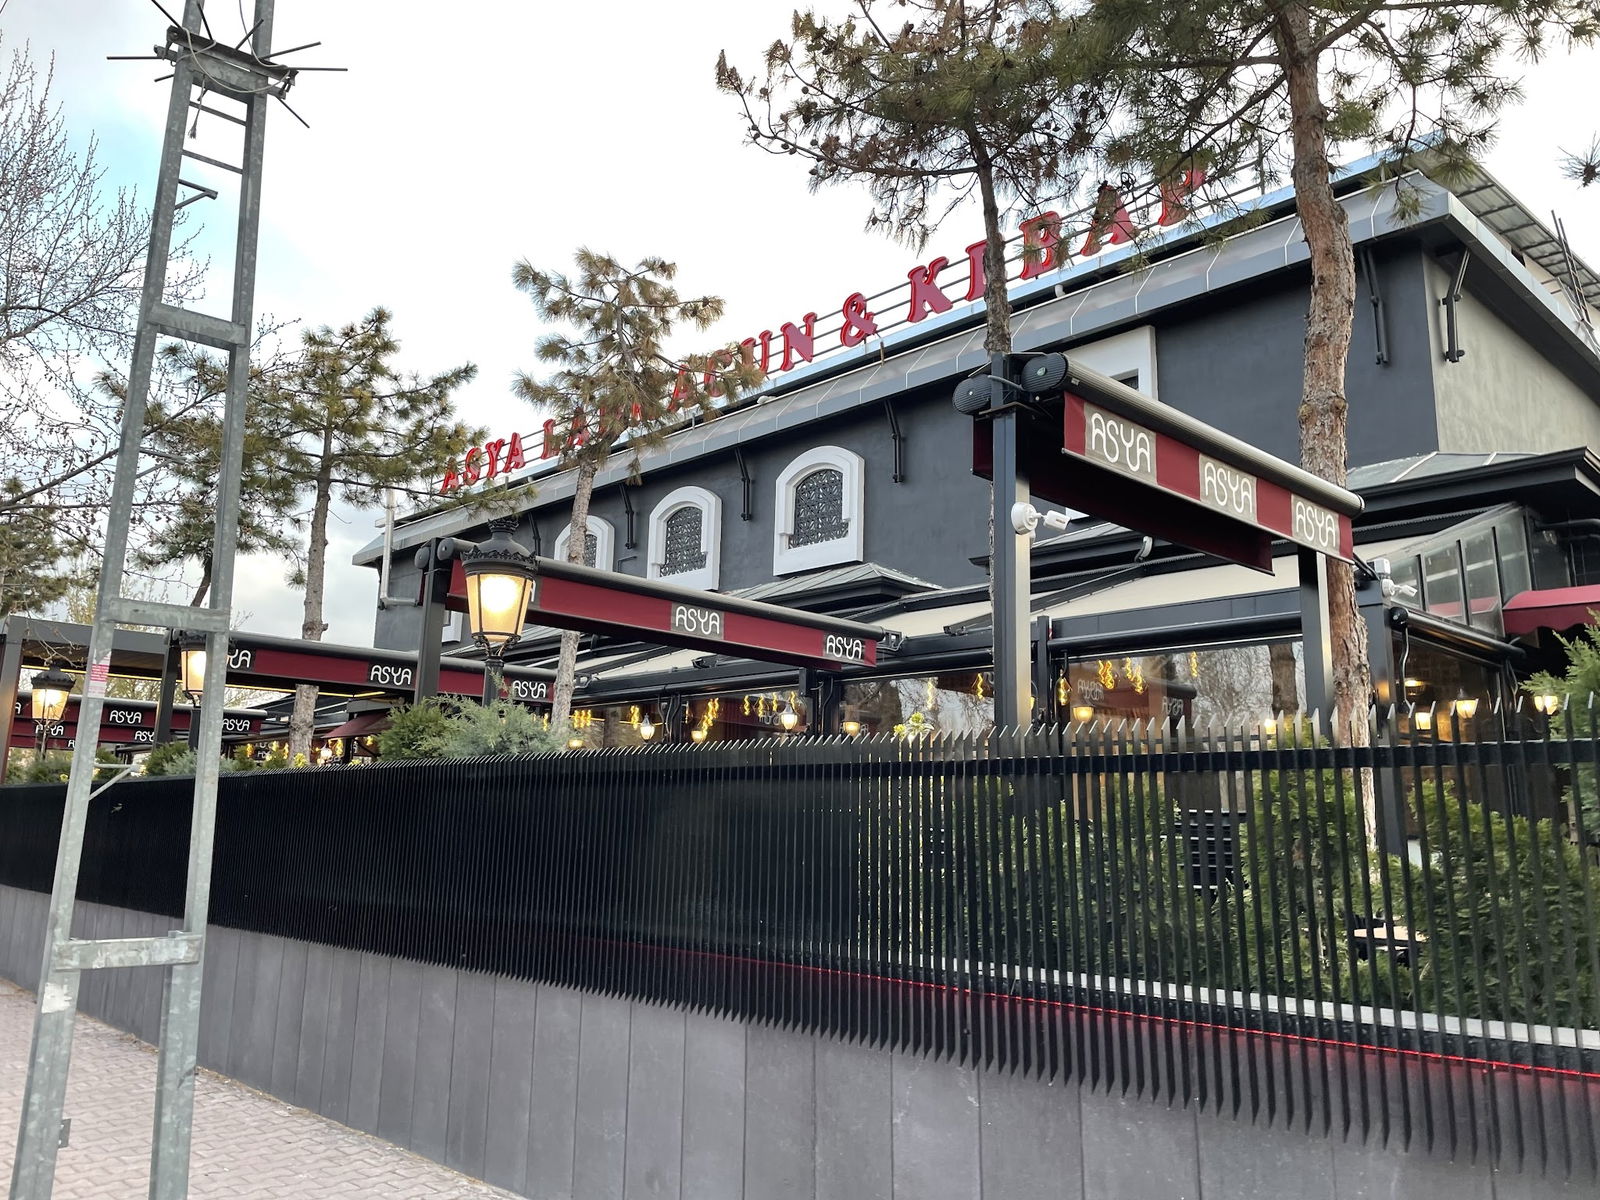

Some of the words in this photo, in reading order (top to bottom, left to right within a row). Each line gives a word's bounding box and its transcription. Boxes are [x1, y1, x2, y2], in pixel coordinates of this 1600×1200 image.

[439, 432, 526, 495] ASYA
[840, 292, 878, 348] &
[1091, 412, 1151, 473] ASYA
[1204, 461, 1253, 514] ASYA
[1295, 501, 1336, 548] ASYA
[675, 605, 721, 635] ASYA
[826, 634, 863, 660] ASYA
[227, 648, 251, 669] YA
[370, 664, 412, 686] ASYA
[512, 679, 546, 699] ASYA
[109, 709, 142, 724] ASYA
[222, 718, 250, 731] ASYA
[35, 724, 64, 736] AYA
[134, 730, 154, 742] ASY
